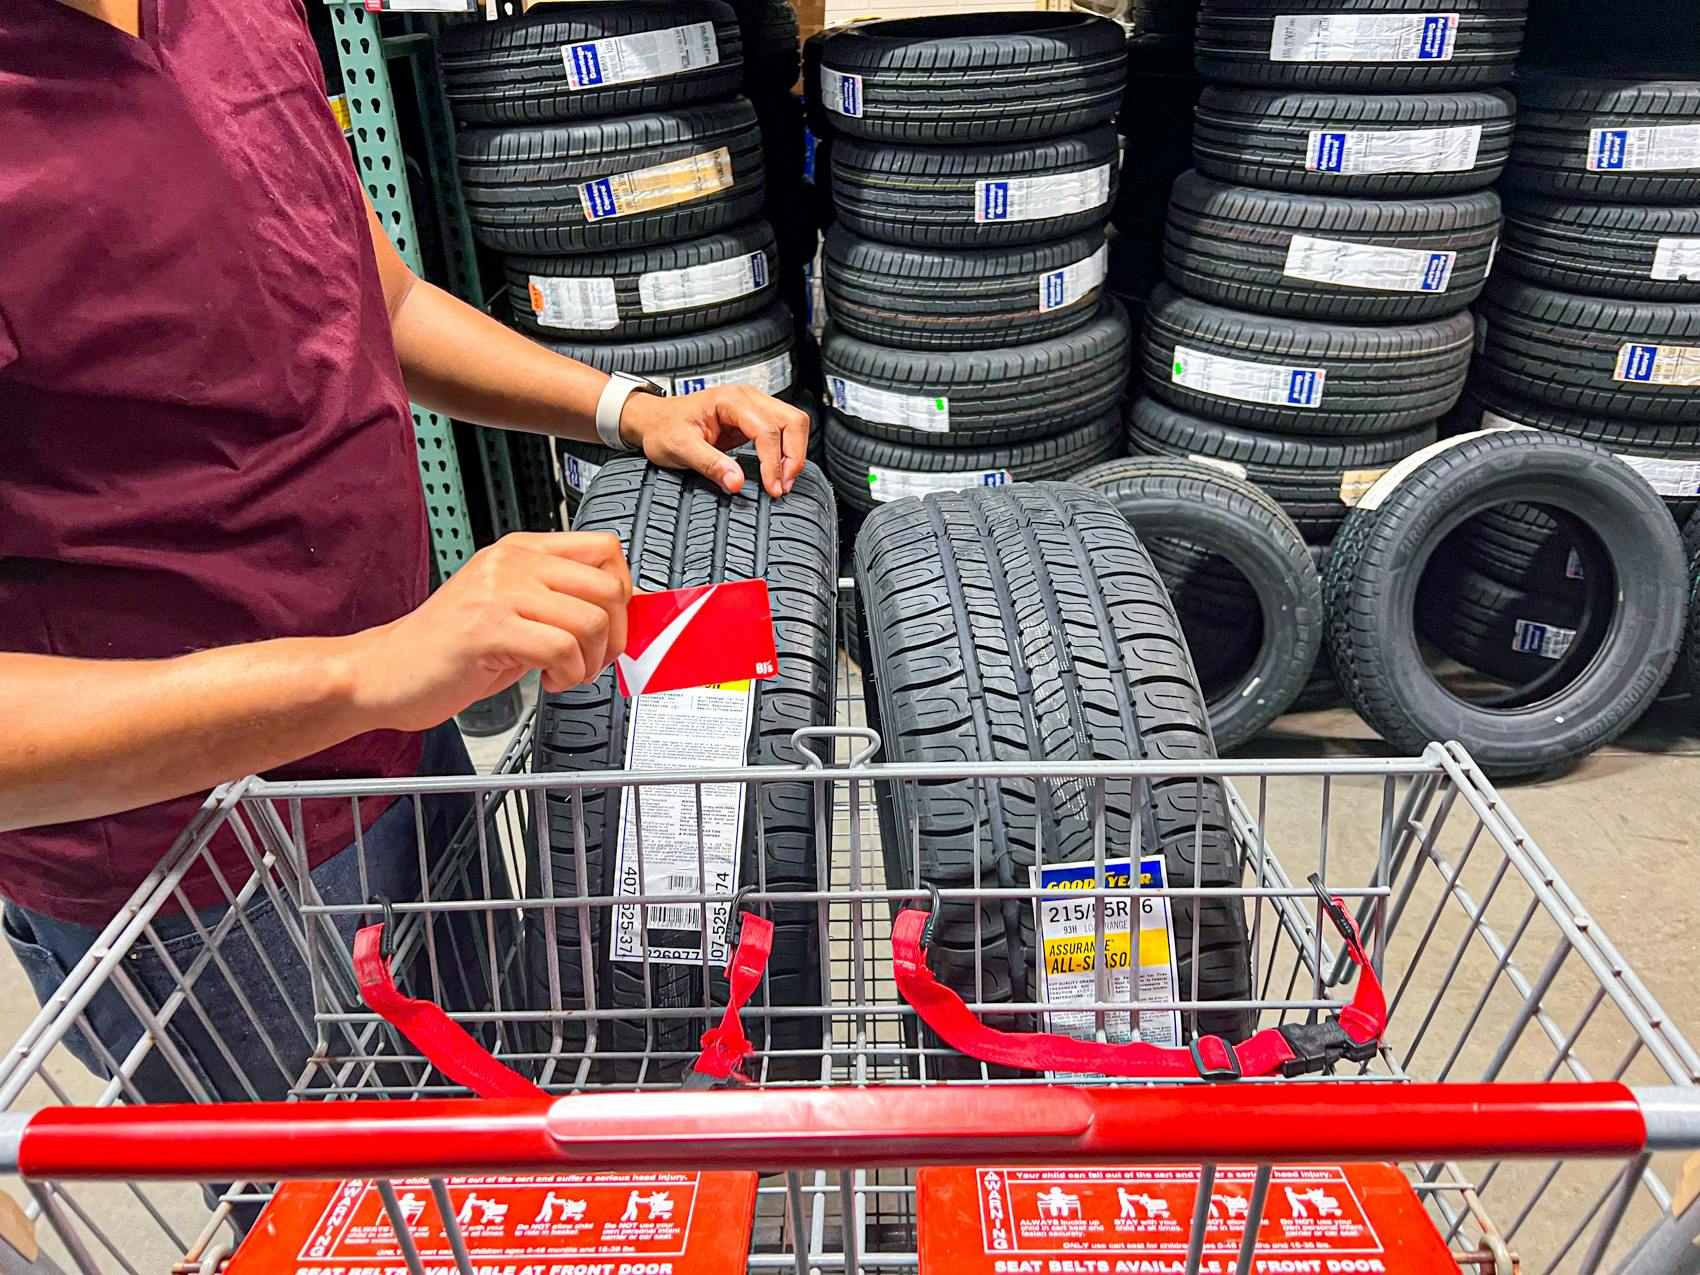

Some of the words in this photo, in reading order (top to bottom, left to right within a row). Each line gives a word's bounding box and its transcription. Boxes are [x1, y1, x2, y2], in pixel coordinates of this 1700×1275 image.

[756, 660, 774, 675] BJ's
[1047, 873, 1152, 890] GOODYER
[1049, 898, 1153, 923] 215/5R6
[1050, 940, 1111, 956] ASSURANE
[534, 1175, 553, 1183] and
[556, 1175, 585, 1183] suffer
[632, 1174, 656, 1182] head
[1016, 1171, 1040, 1179] Your
[1042, 1171, 1066, 1179] child
[1088, 1171, 1103, 1179] fall
[1124, 1171, 1135, 1179] of
[1136, 1171, 1151, 1179] the
[309, 1187, 361, 1256] WARNING
[984, 1180, 1008, 1249] WARNING
[519, 1265, 546, 1275] AT
[550, 1264, 615, 1275] FRONT
[618, 1263, 673, 1275] DOOR
[994, 1260, 1043, 1273] SEAT
[1049, 1260, 1110, 1273] BELTS
[1115, 1260, 1222, 1273] AVAILALE
[1256, 1260, 1321, 1273] FRONT
[1326, 1259, 1386, 1273] DOOR
